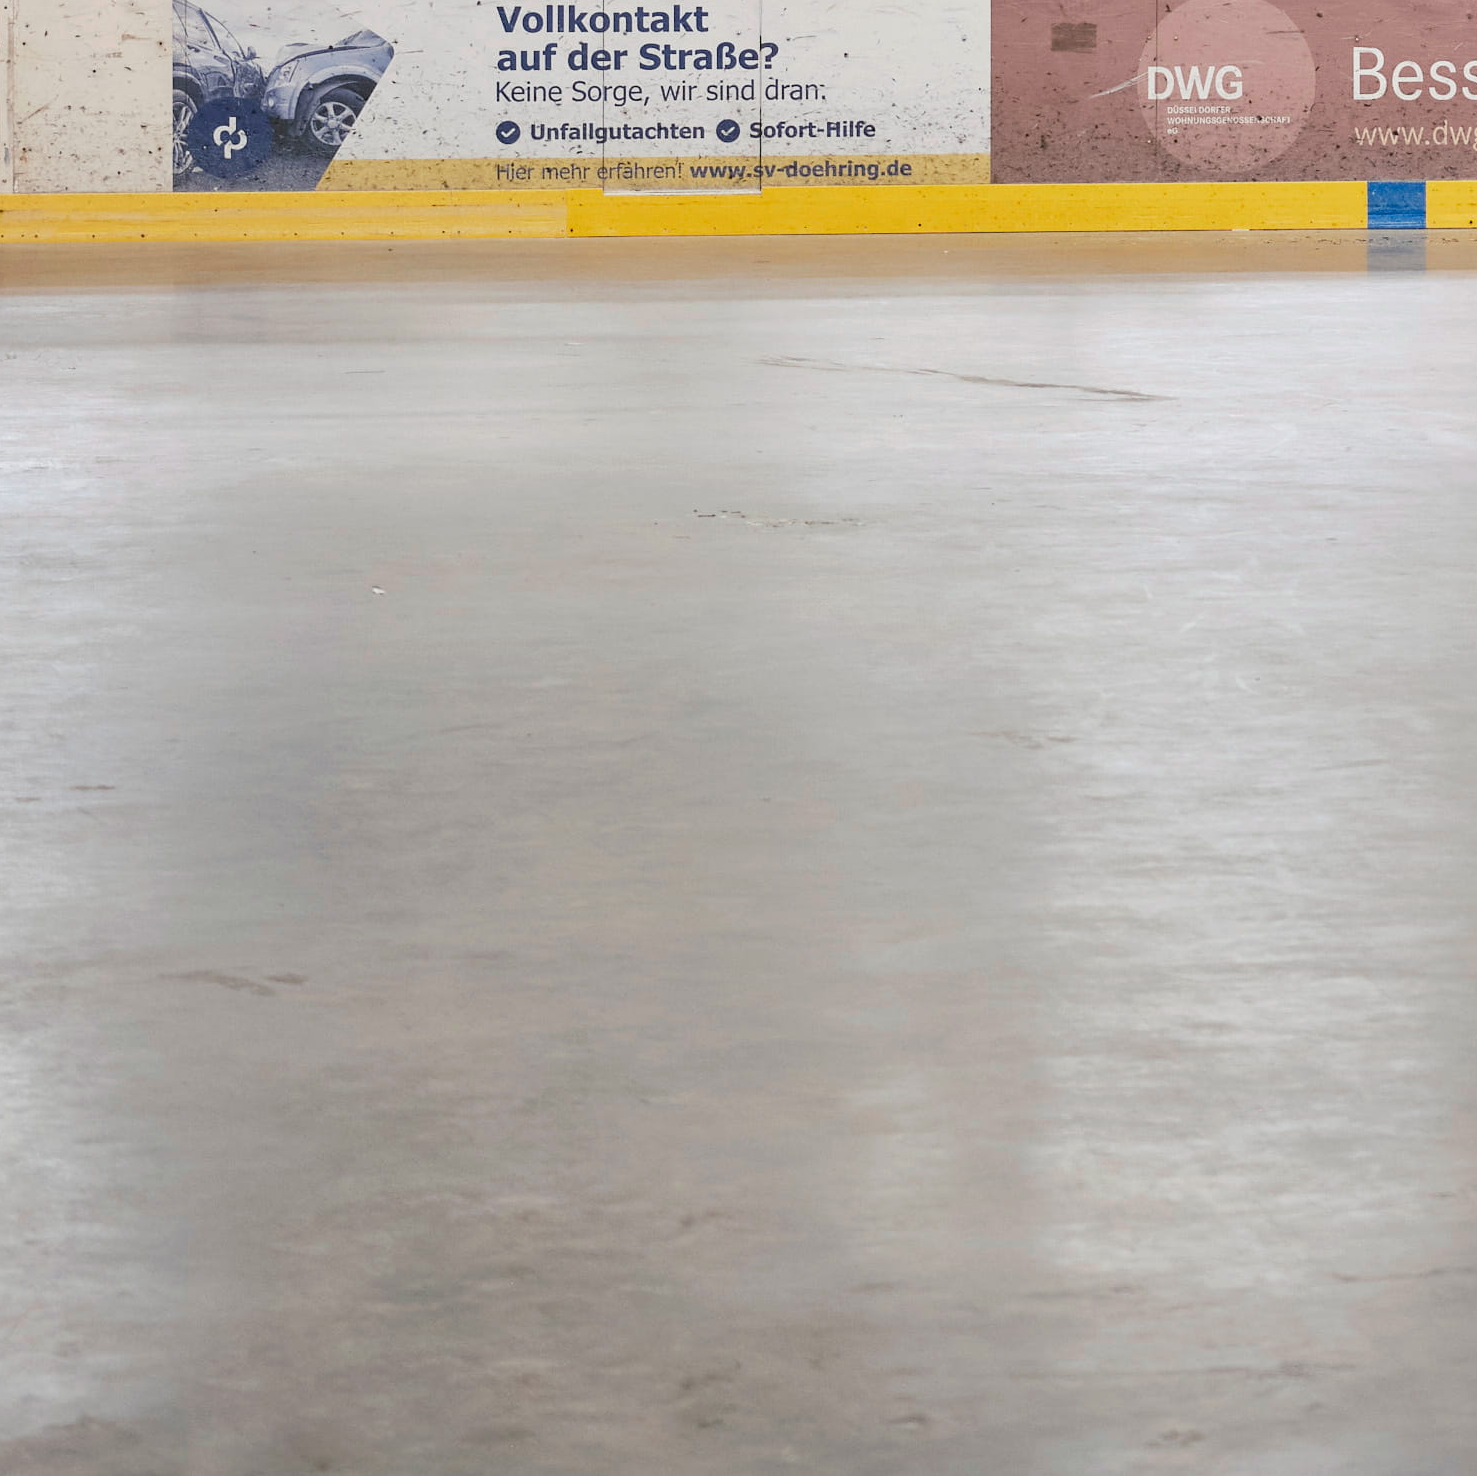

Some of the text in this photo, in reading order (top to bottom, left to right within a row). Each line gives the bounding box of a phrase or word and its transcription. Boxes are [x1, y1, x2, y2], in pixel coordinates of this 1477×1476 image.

[496, 5, 709, 33] Vollkontakt
[497, 41, 779, 71] auf der Straße?
[495, 82, 562, 102] Keine
[572, 81, 650, 107] Sorge,
[661, 81, 699, 101] wir
[706, 80, 756, 101] sind
[1147, 65, 1243, 100] DWG
[530, 121, 876, 143] Unfallgutachten Sofort-Hilfe
[496, 160, 912, 183] Hier mehr erfahren! www.sv-doehring.de
